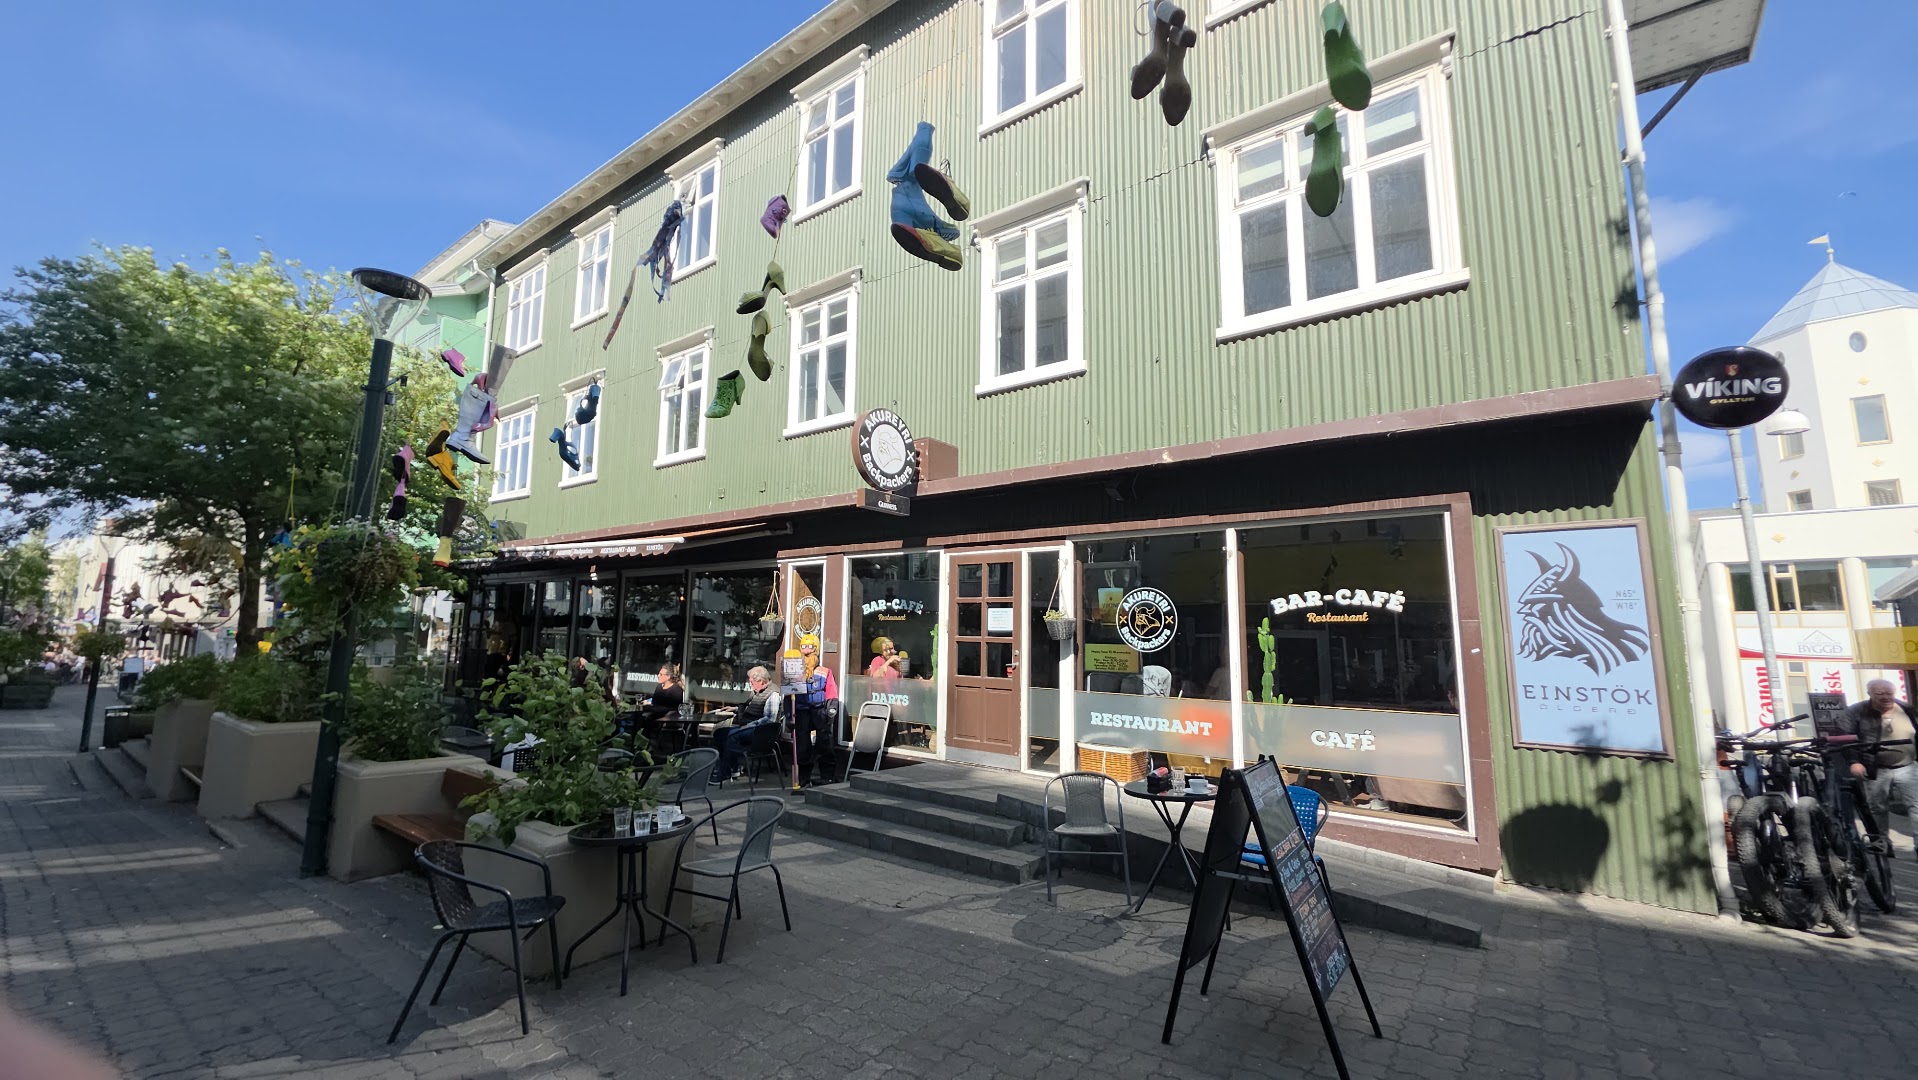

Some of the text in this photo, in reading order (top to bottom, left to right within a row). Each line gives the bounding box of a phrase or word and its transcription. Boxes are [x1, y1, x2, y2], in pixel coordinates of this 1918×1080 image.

[1685, 377, 1782, 399] VÍKING
[864, 409, 913, 444] AKUREYRI
[862, 453, 912, 488] Backpackers
[862, 598, 923, 615] BAR-CAFÉ
[1122, 591, 1171, 612] AKUREYRI
[1271, 588, 1406, 615] BAR-CAFÉ
[1307, 611, 1369, 623] Restaurant
[1120, 626, 1171, 650] Backpackers
[872, 692, 909, 706] DARTS
[1522, 684, 1653, 705] EINSTÖK
[1090, 711, 1213, 736] RESTAURANT
[1310, 729, 1376, 752] CAFÉ
